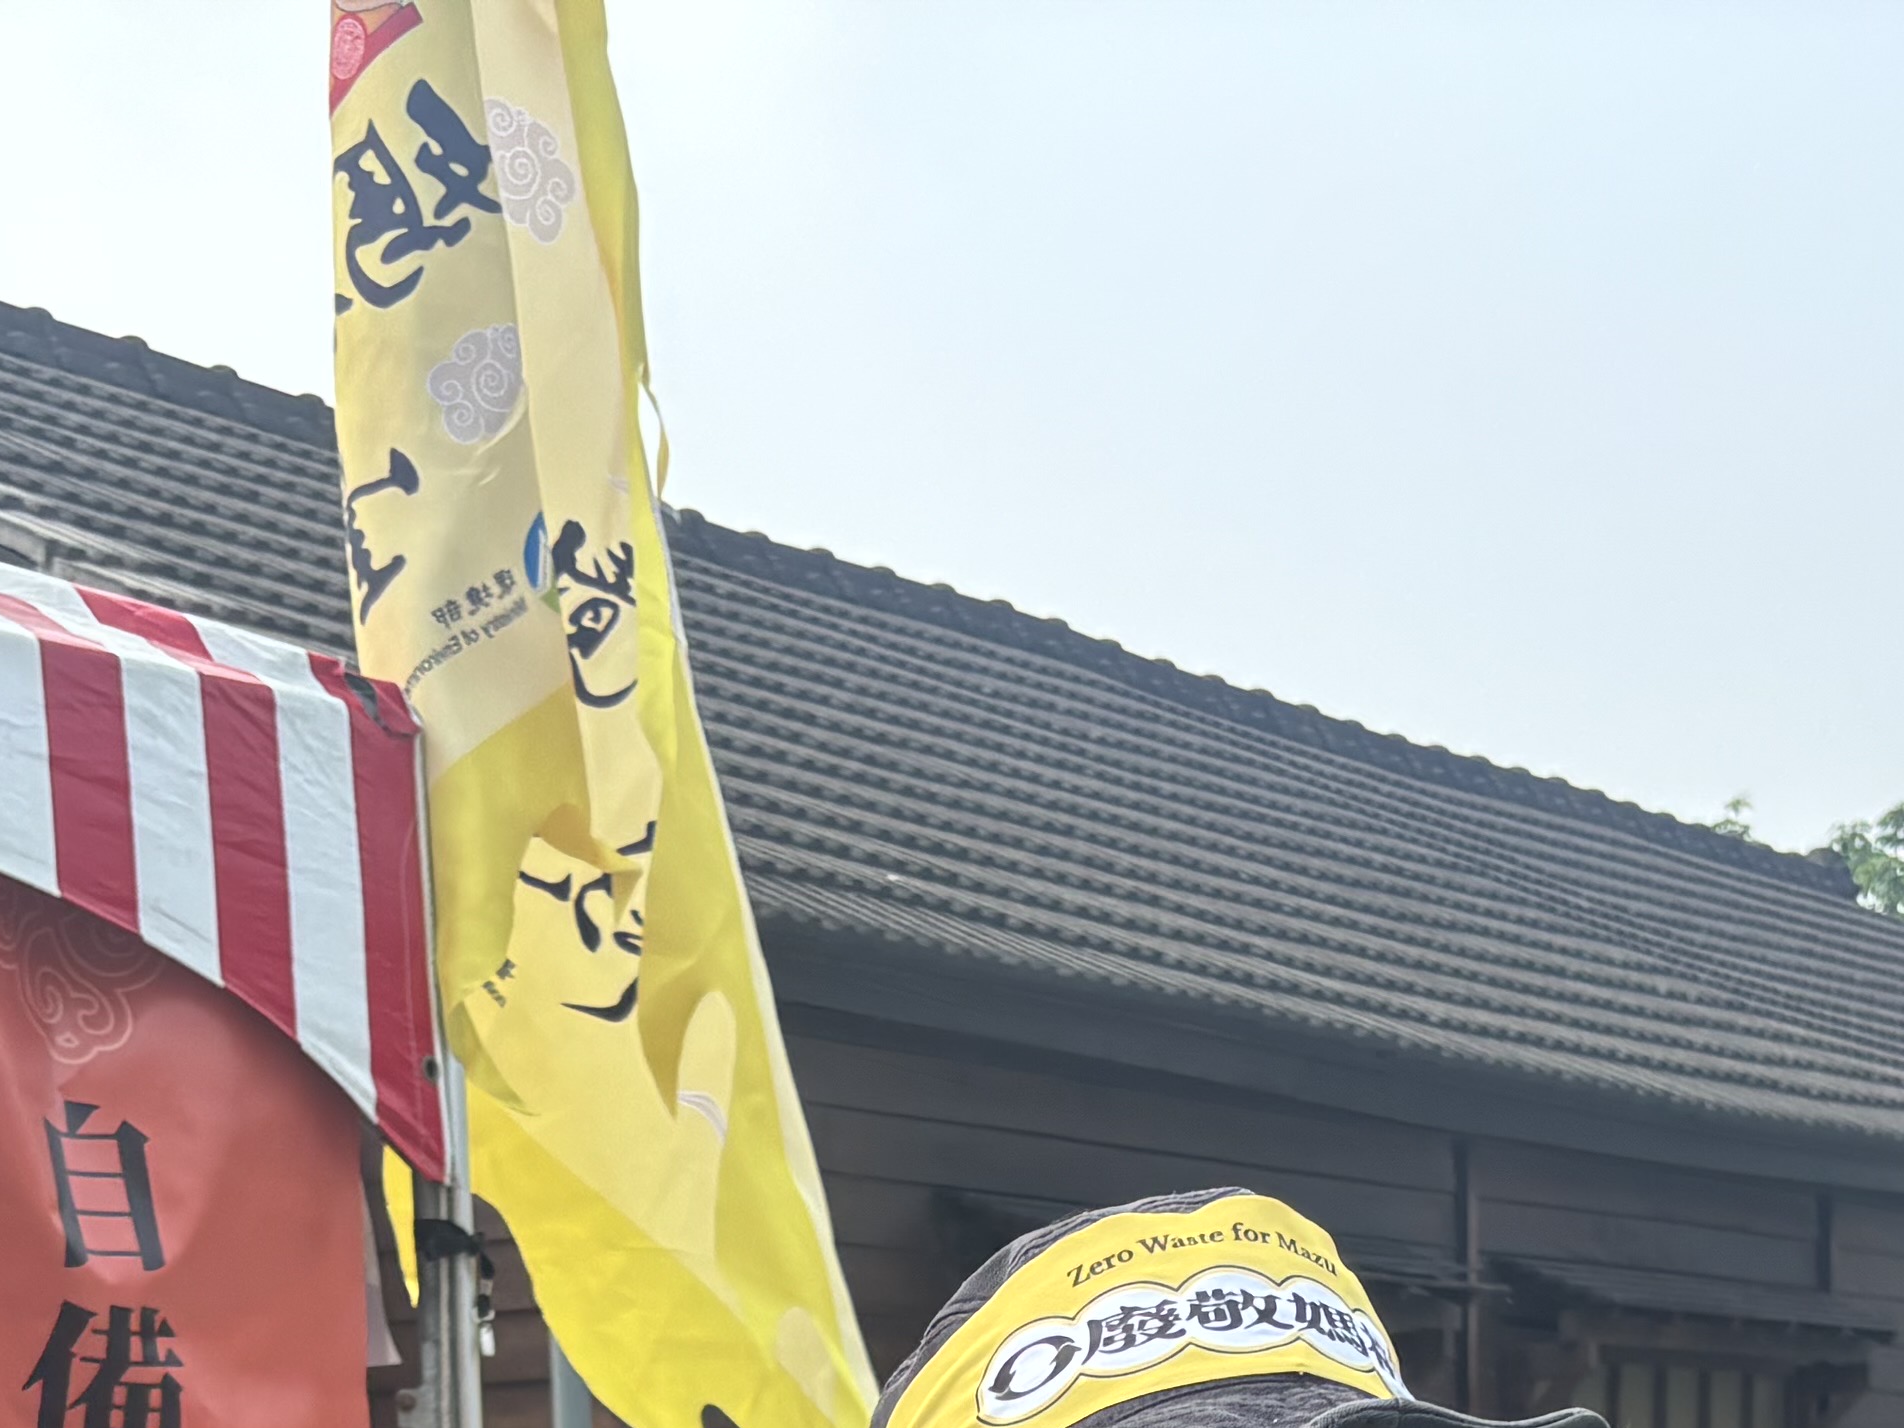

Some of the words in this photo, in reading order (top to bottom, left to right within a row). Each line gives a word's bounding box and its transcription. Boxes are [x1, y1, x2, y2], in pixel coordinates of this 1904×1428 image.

[1067, 1249, 1134, 1288] Zero
[1137, 1229, 1224, 1254] Waste
[1232, 1222, 1271, 1243] for
[1275, 1231, 1338, 1277] Mazu
